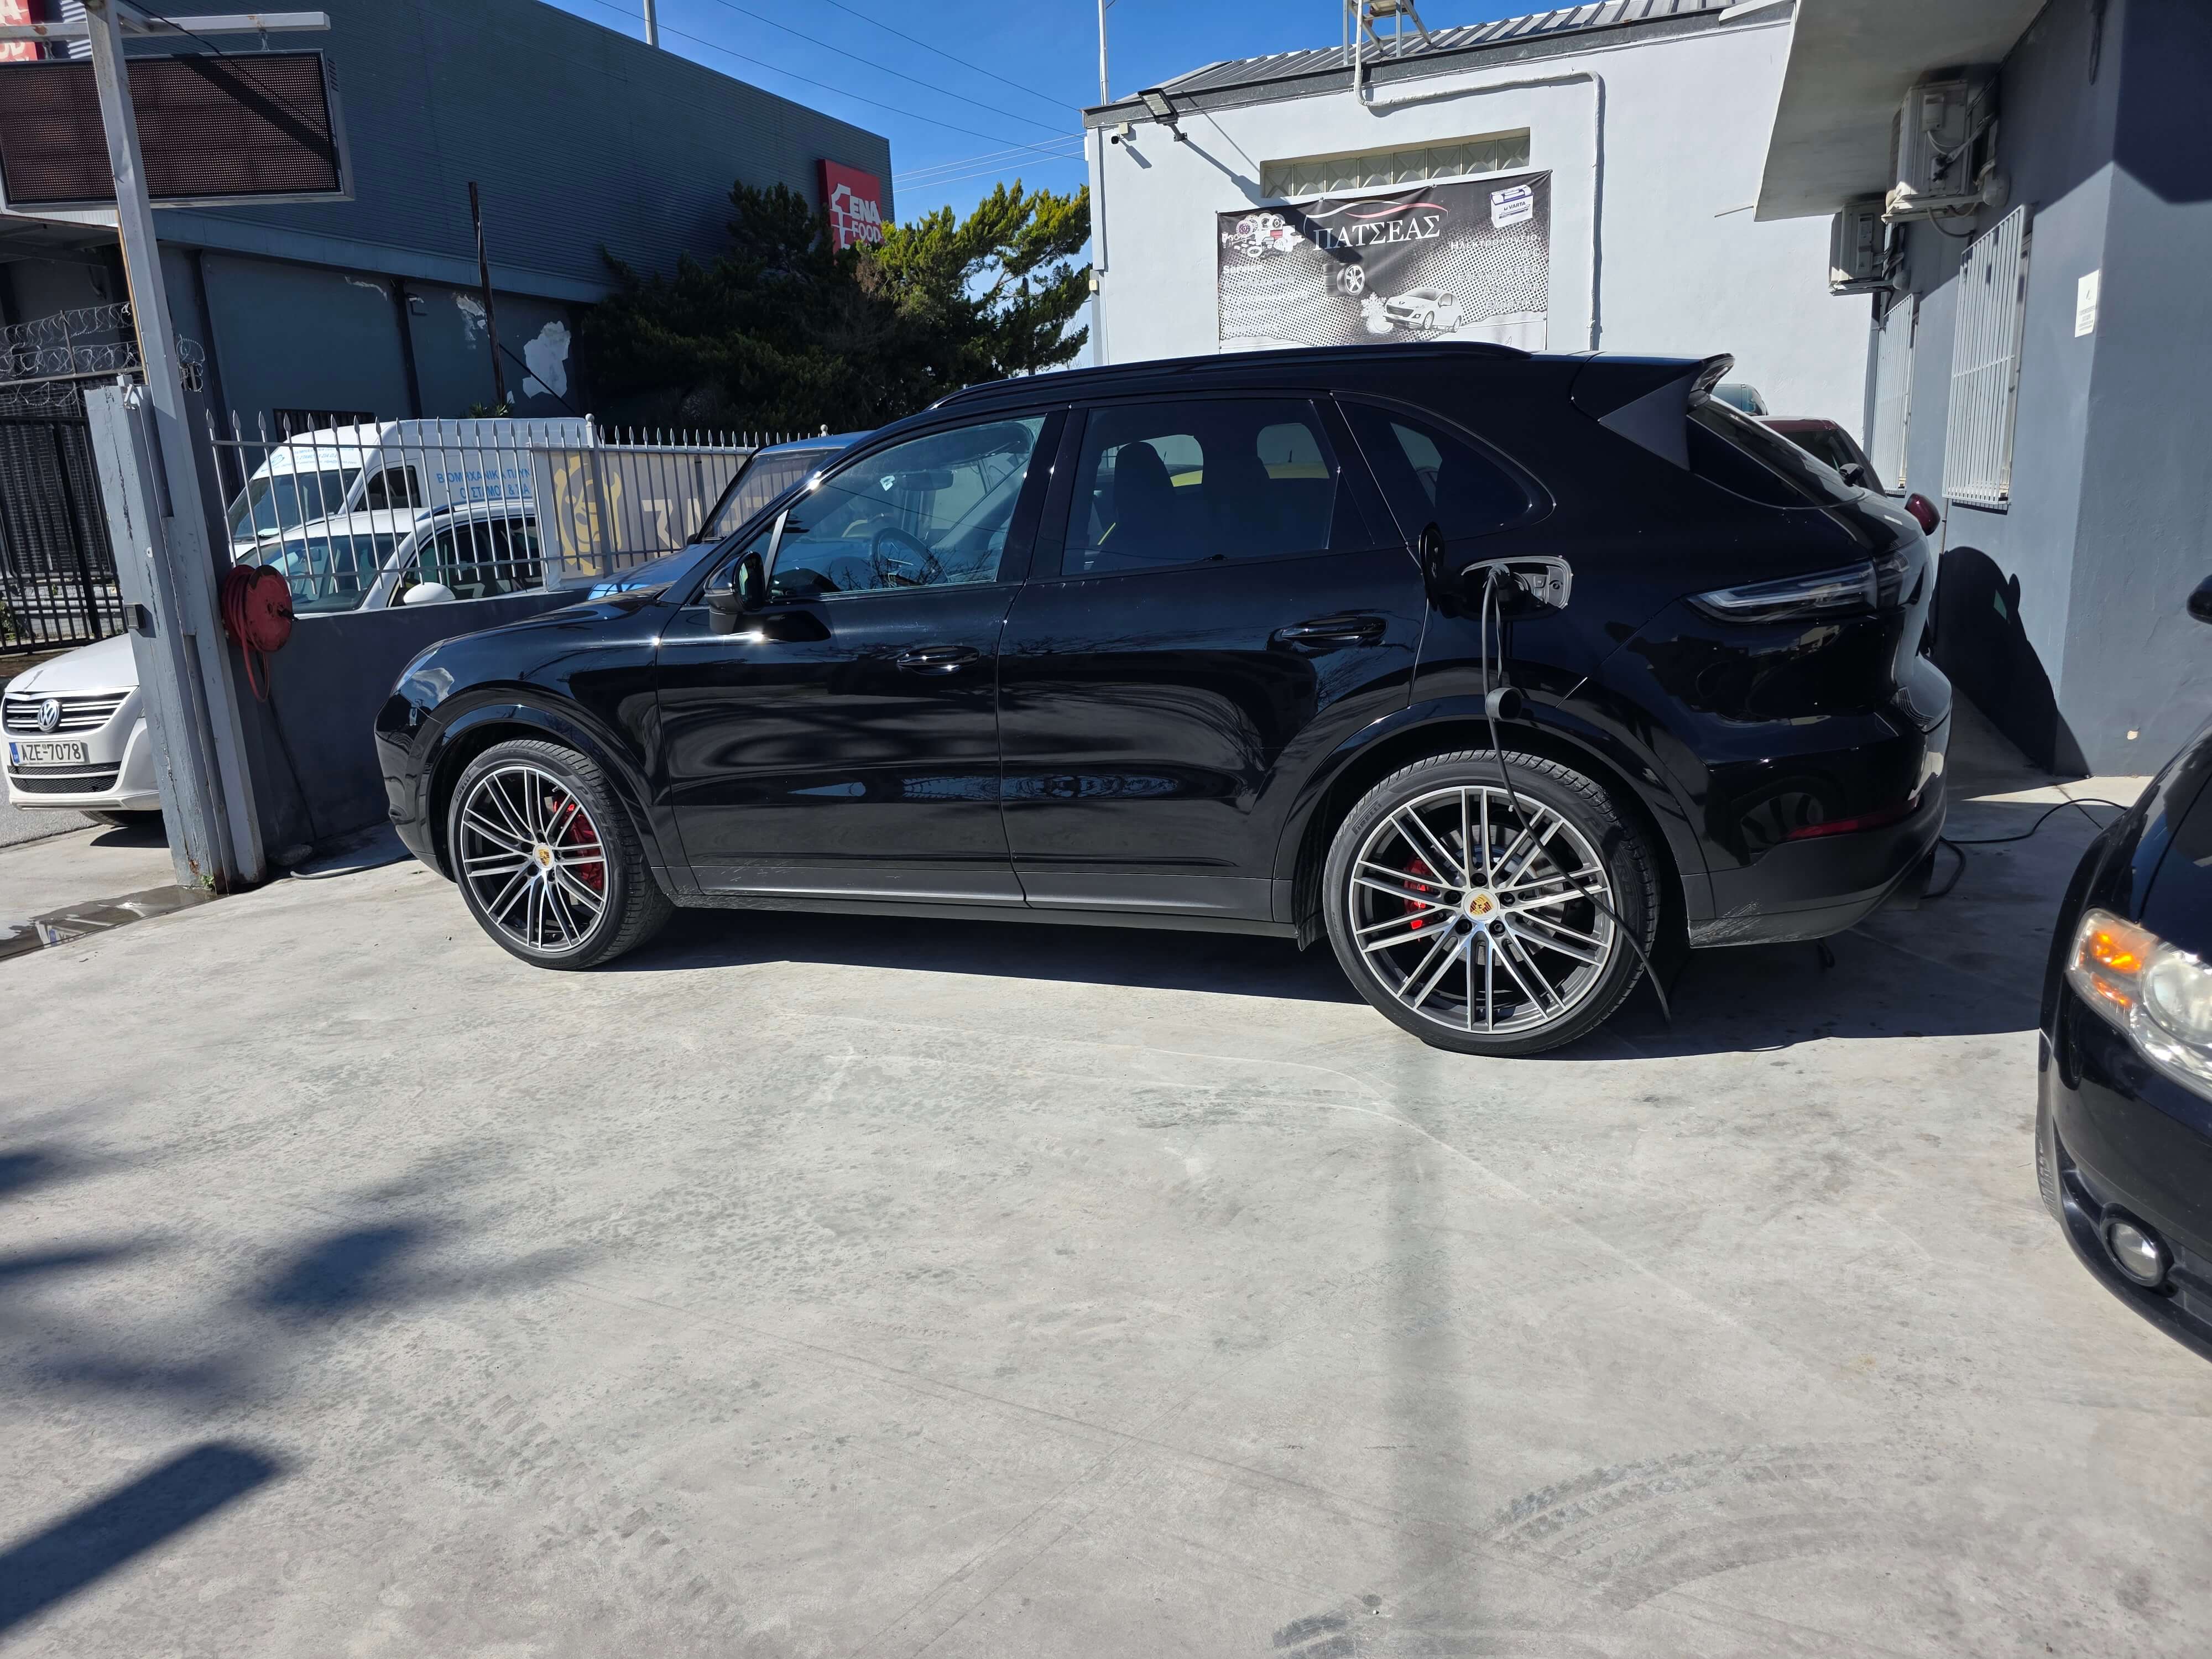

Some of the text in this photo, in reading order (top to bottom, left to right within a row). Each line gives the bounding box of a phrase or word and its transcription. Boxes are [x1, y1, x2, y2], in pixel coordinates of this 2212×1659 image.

[1313, 215, 1441, 251] ΠΑΤΣΕΑΣ
[1223, 264, 1264, 274] Service
[436, 469, 507, 483] ΒΟΜΧΑΝΙΚ
[508, 484, 515, 495] &
[1351, 800, 1382, 836] PIRELLI
